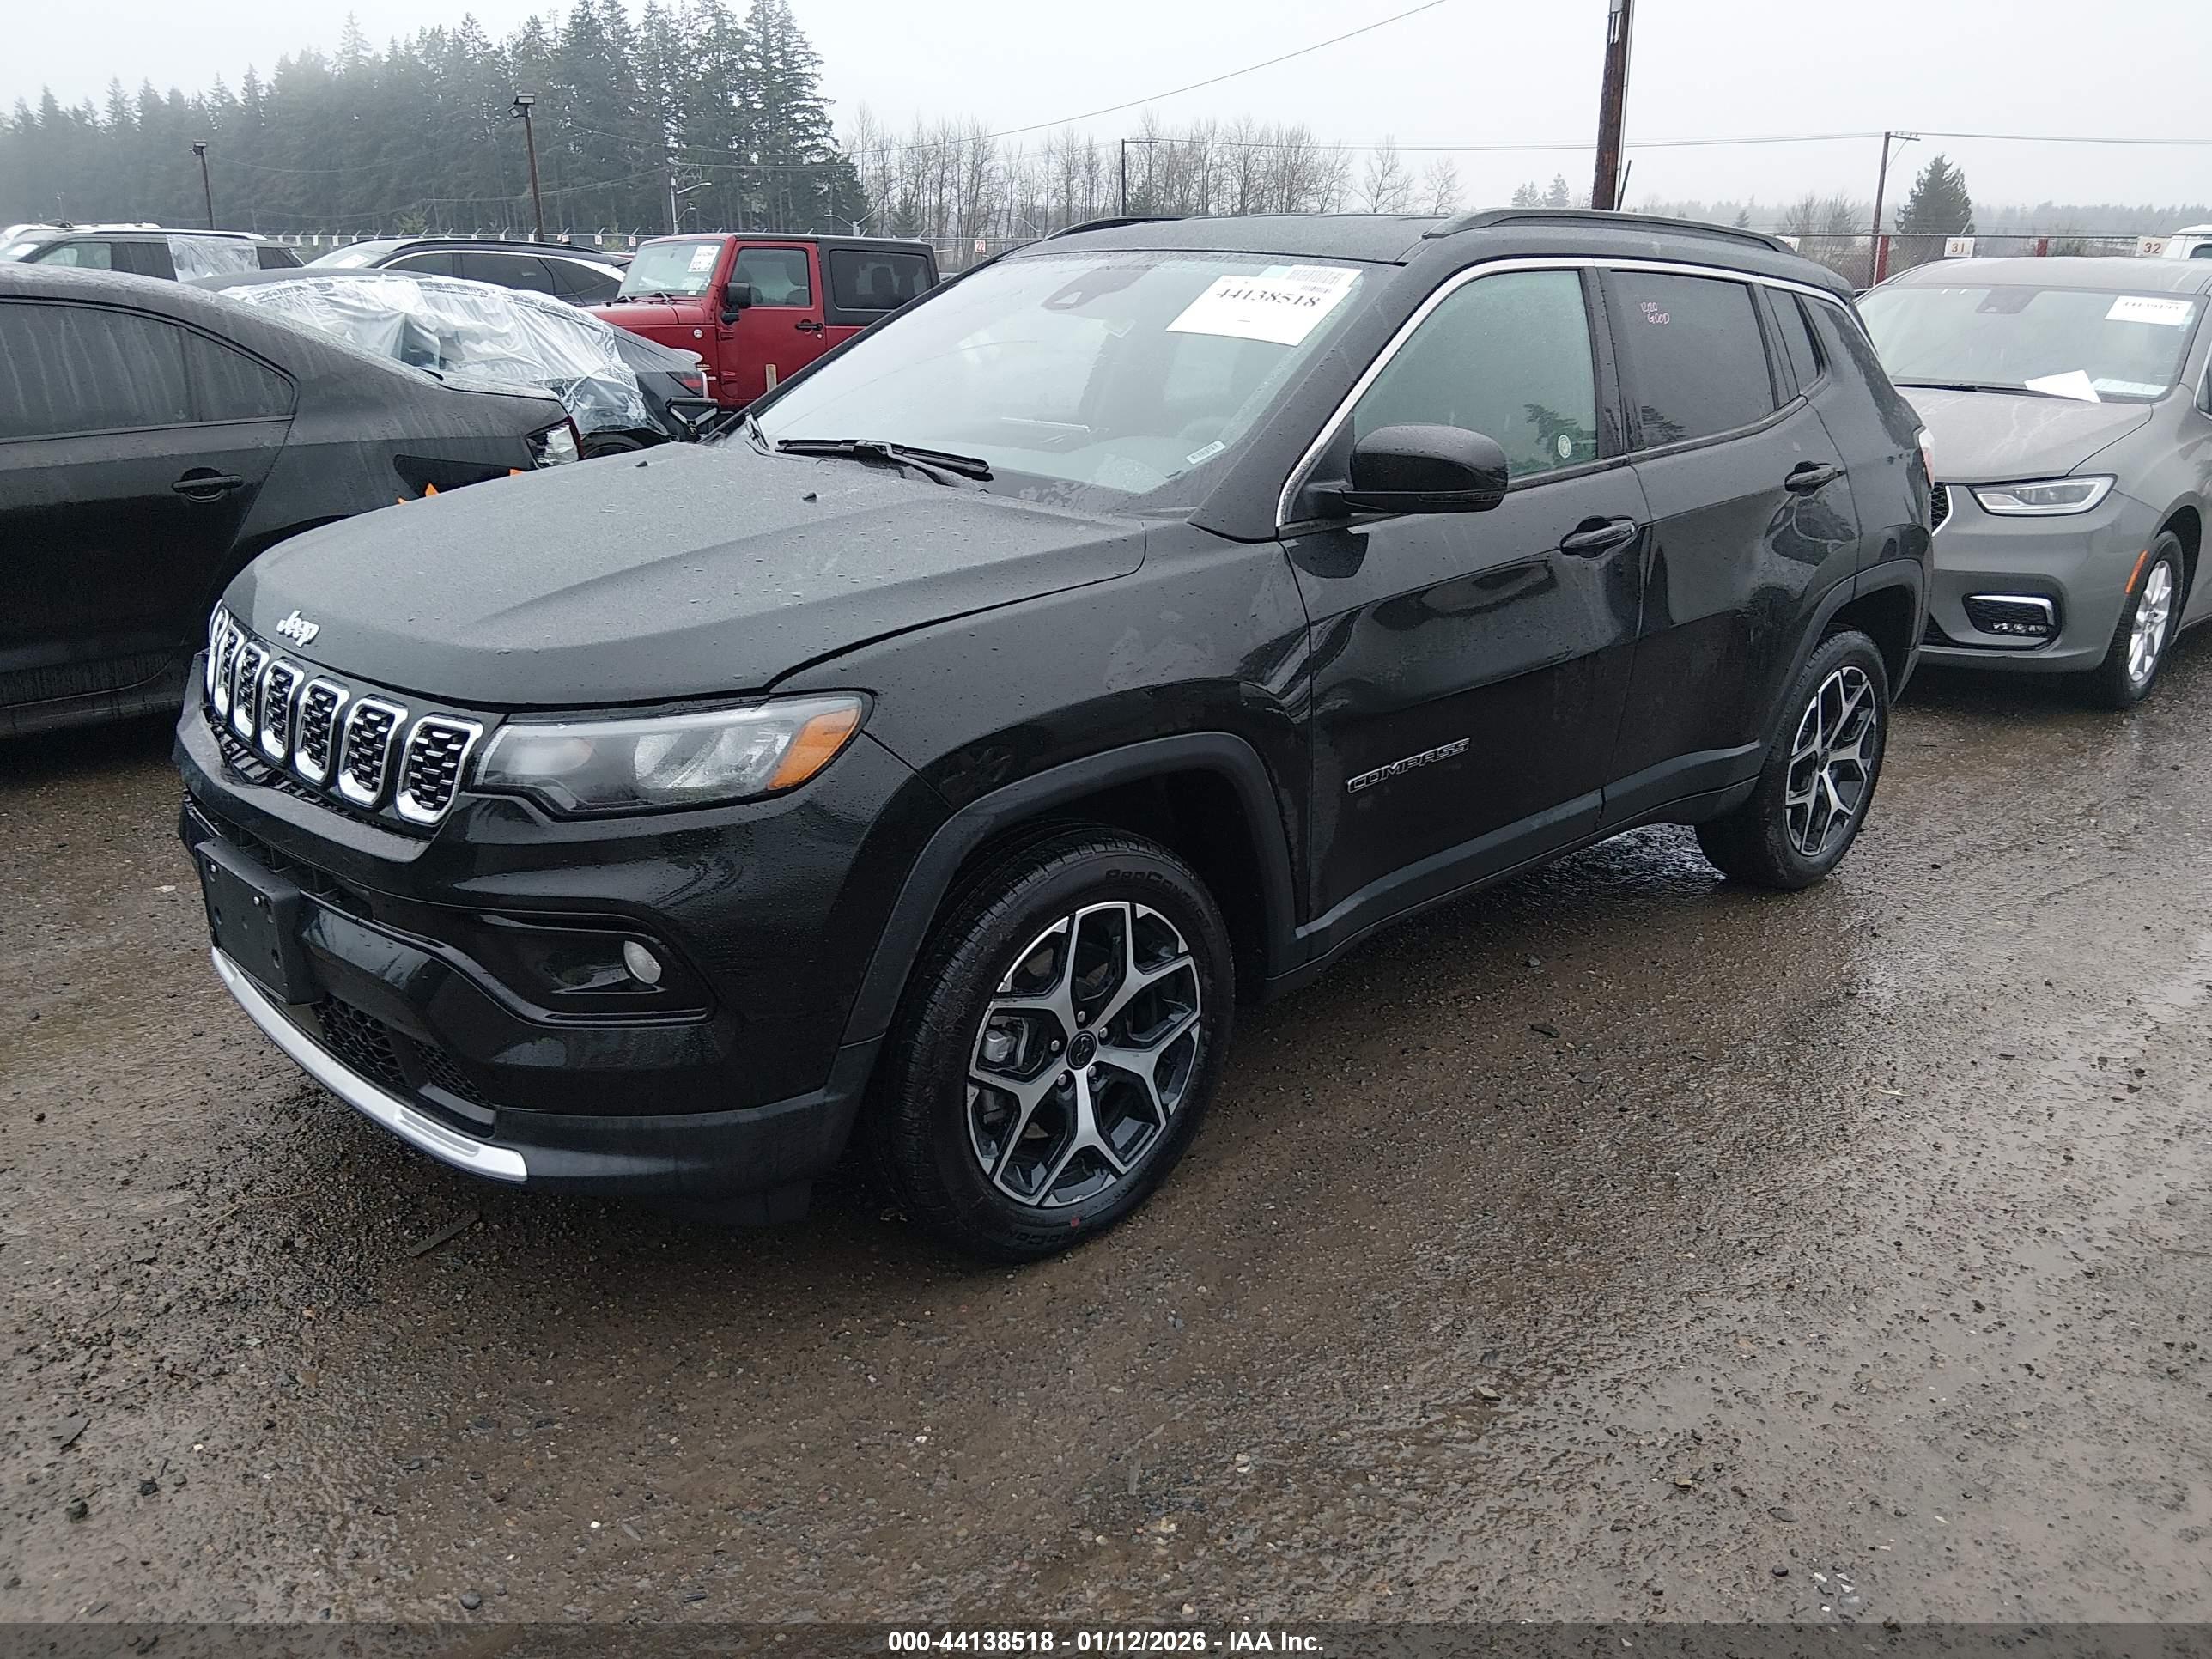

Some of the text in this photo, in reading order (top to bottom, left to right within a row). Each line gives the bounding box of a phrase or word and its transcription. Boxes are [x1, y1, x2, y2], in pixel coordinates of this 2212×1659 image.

[1951, 242, 1965, 254] 31
[2143, 242, 2161, 254] 32
[1216, 288, 1321, 307] 44138518
[1647, 313, 1670, 325] GOOD
[276, 610, 319, 647] Jeep
[1346, 737, 1471, 793] COMPASS
